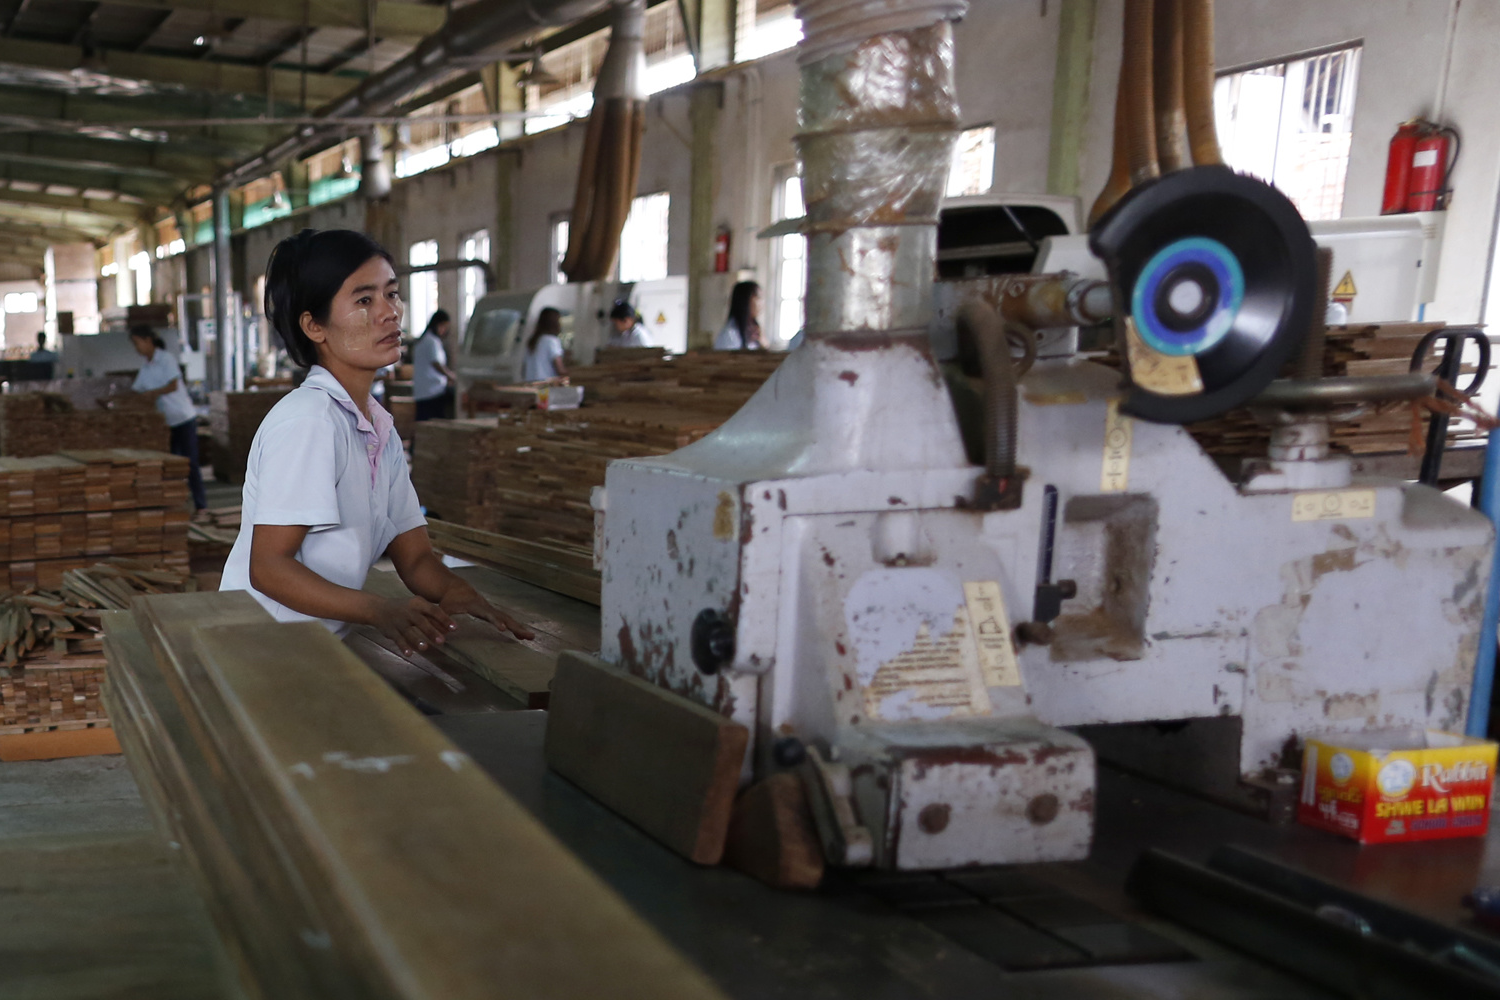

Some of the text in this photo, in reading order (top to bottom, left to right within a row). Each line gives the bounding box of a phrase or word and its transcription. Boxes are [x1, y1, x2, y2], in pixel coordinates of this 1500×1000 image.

[1421, 761, 1488, 793] Rabbit
[1375, 800, 1424, 818] SHWE
[1427, 798, 1448, 814] LA
